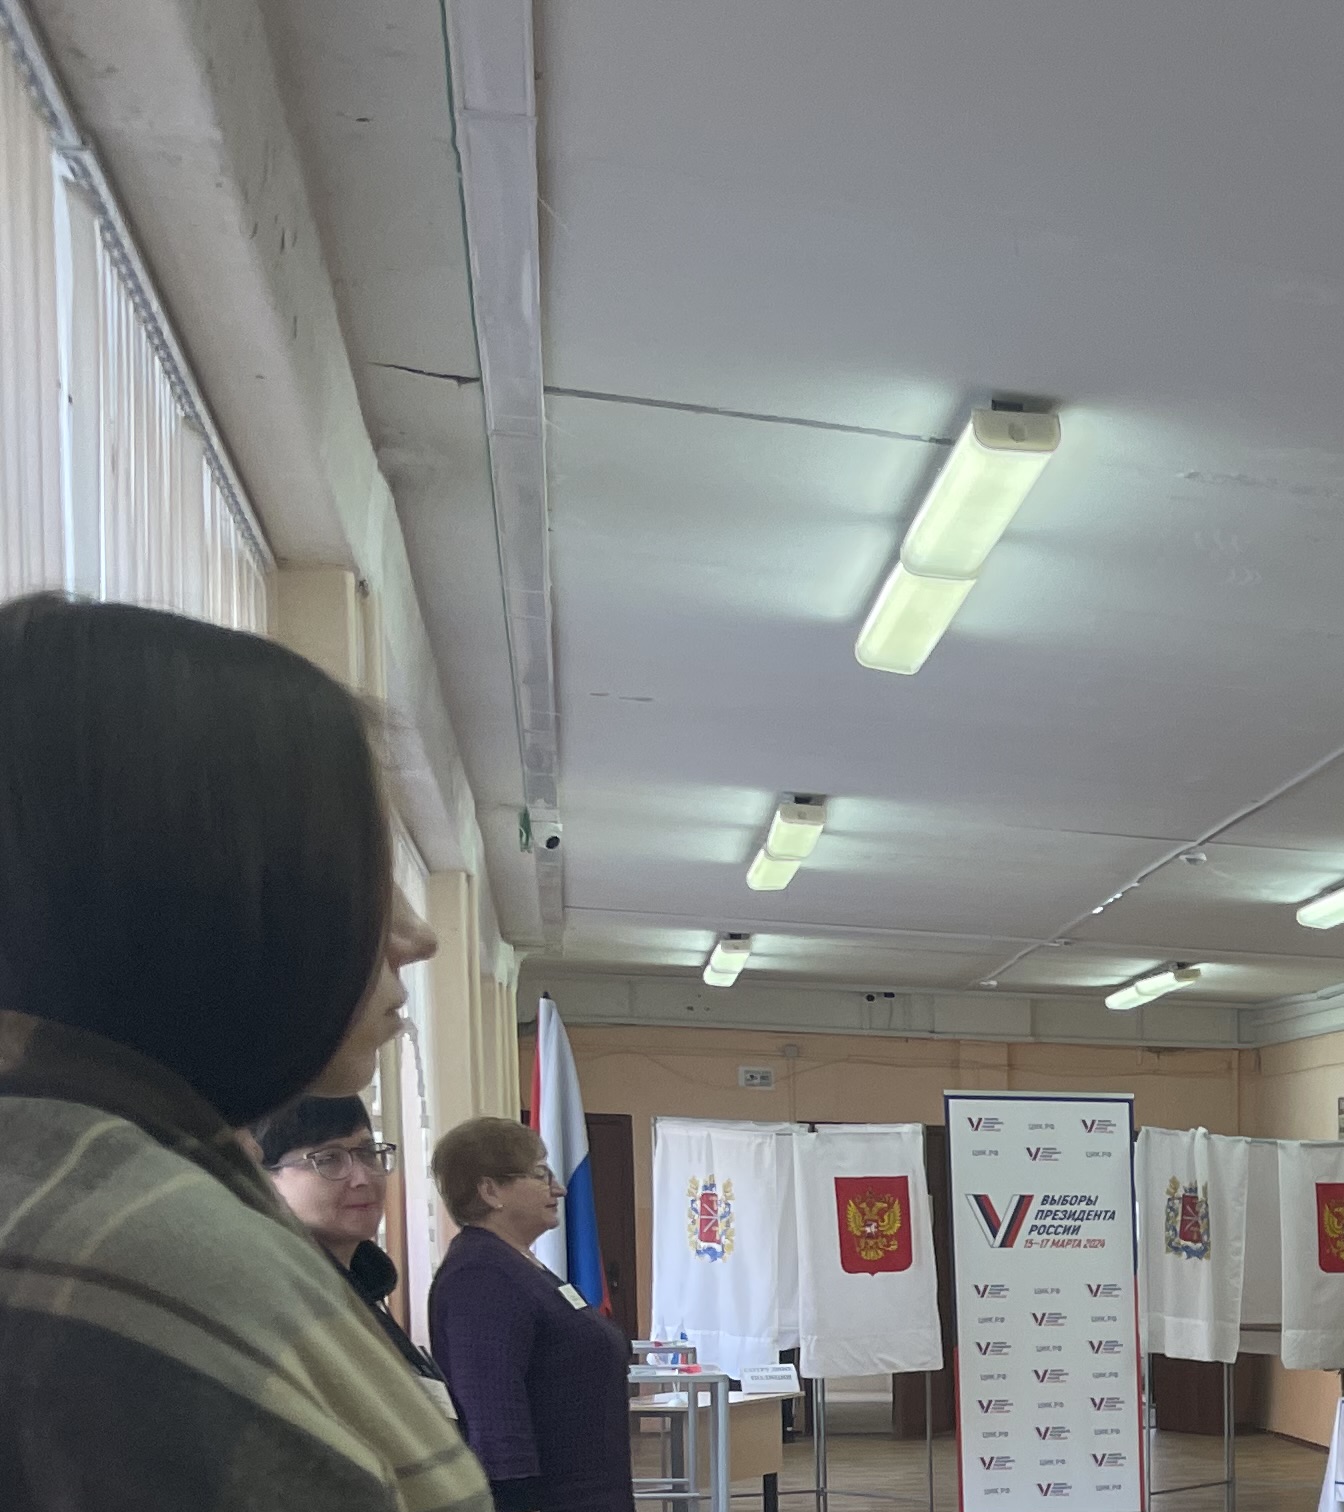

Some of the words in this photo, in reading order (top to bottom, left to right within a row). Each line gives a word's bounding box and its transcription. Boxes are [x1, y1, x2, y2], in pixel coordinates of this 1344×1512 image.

[1040, 1195, 1099, 1207] ВЫБОРЫ
[1034, 1209, 1116, 1222] ПРЕЗИДЕНТА
[1028, 1224, 1081, 1236] РОССИИ
[1050, 1238, 1082, 1249] МАРТА
[1083, 1238, 1106, 1249] 2024
